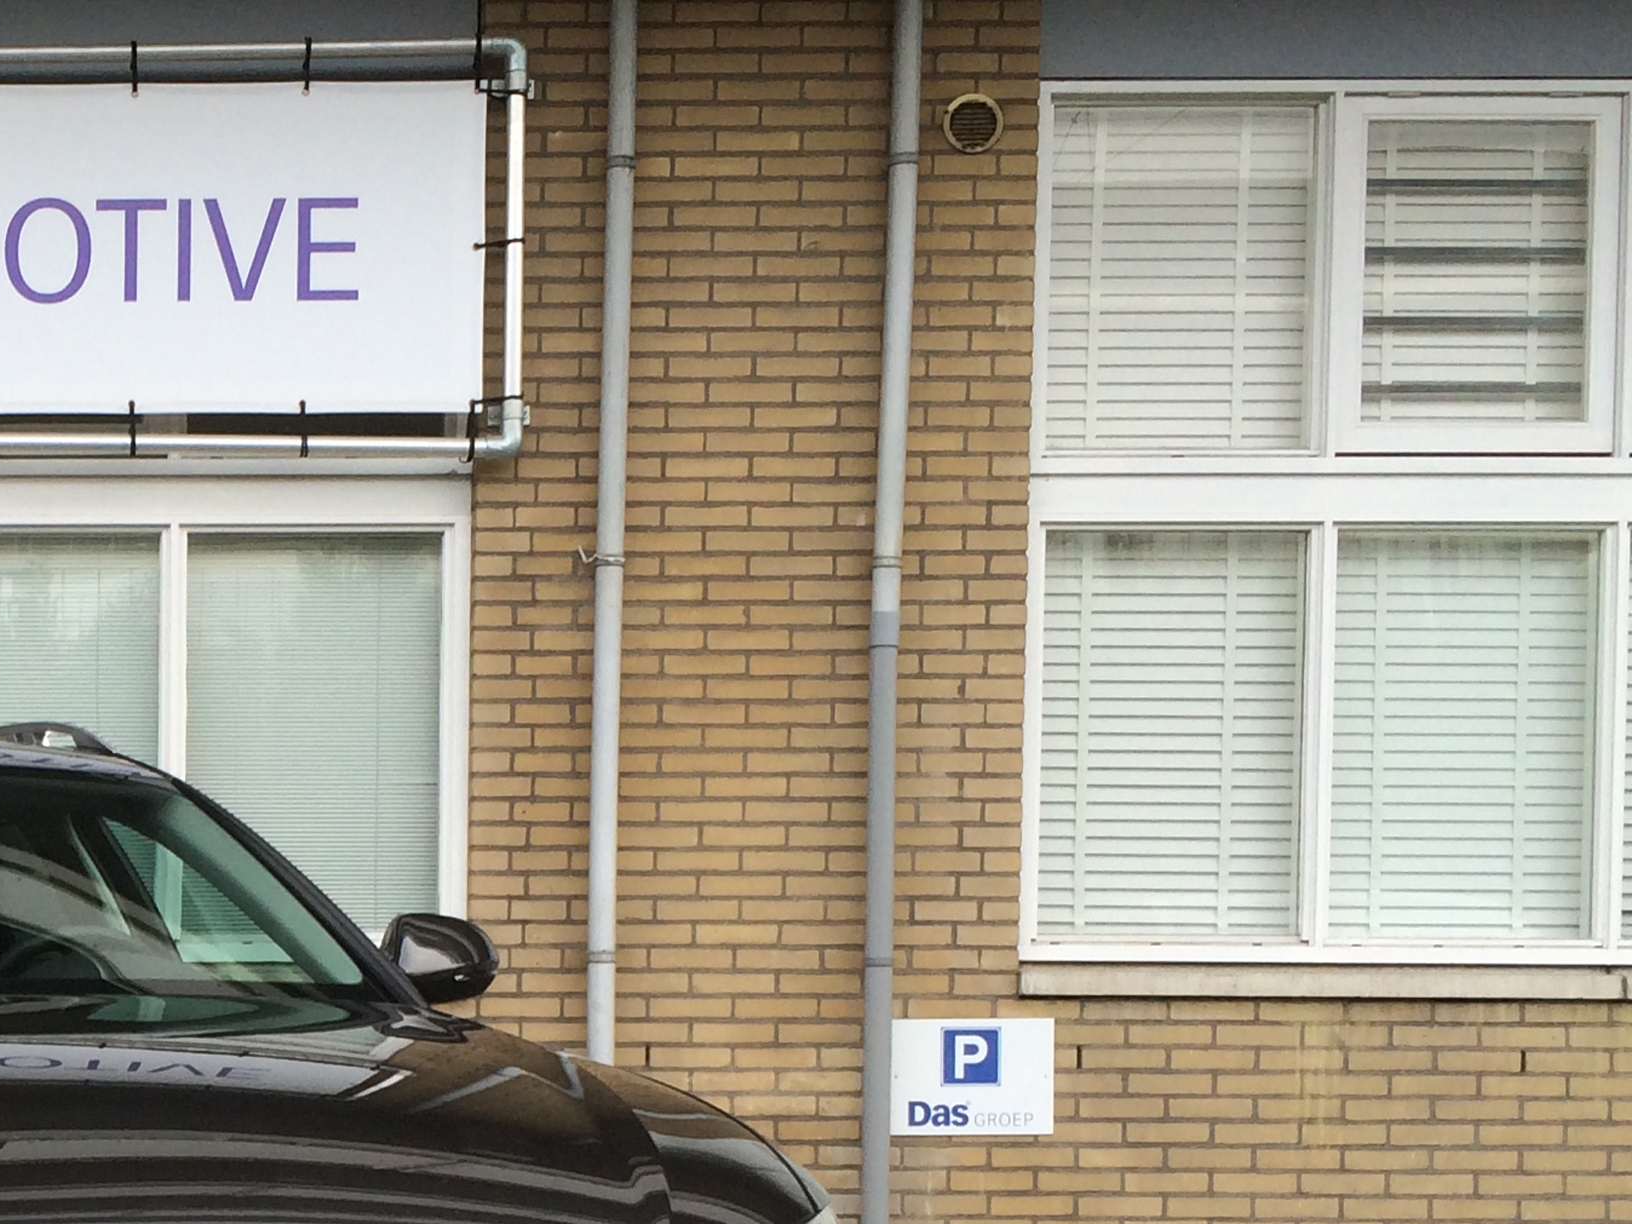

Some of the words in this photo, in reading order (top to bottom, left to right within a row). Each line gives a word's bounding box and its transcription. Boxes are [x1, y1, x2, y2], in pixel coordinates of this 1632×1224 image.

[954, 1035, 988, 1079] P
[907, 1101, 969, 1127] Das
[974, 1112, 1034, 1127] GROEP
